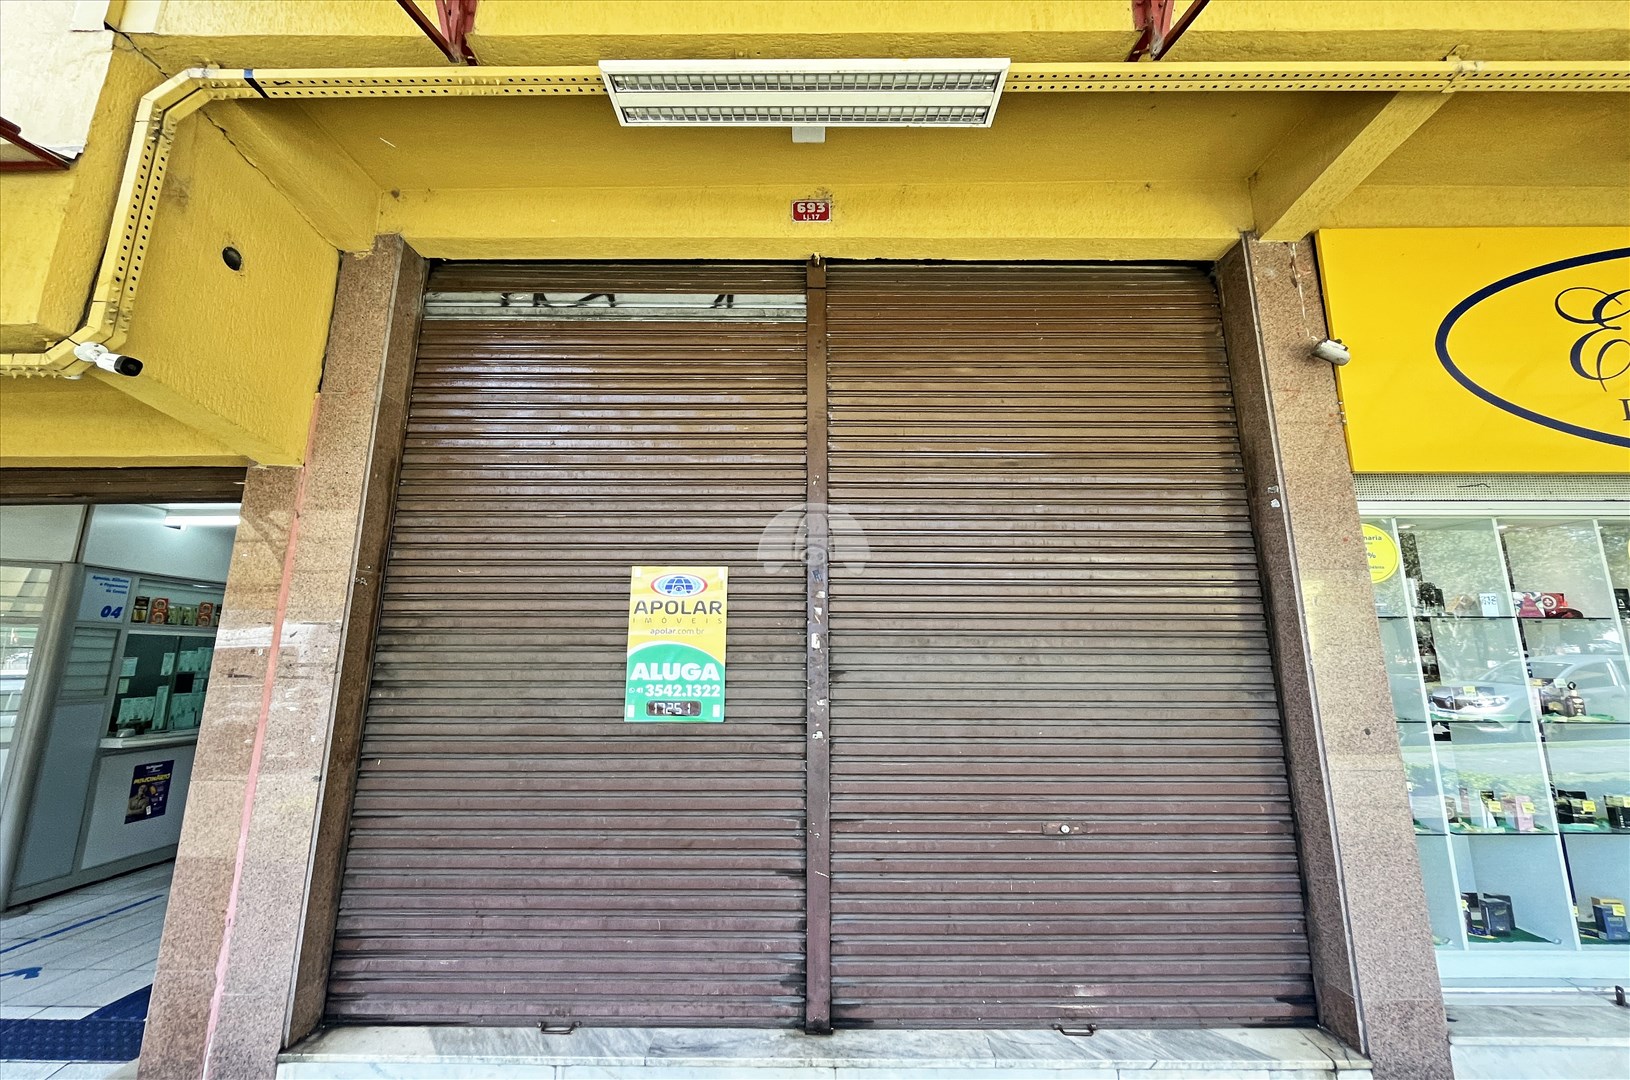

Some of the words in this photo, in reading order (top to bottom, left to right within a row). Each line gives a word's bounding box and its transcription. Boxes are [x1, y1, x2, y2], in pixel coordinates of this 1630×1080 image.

[797, 202, 826, 213] 693
[101, 605, 123, 619] 04
[633, 600, 722, 615] APOLAR
[629, 662, 721, 681] ALUGA
[645, 684, 721, 697] 3542.1322
